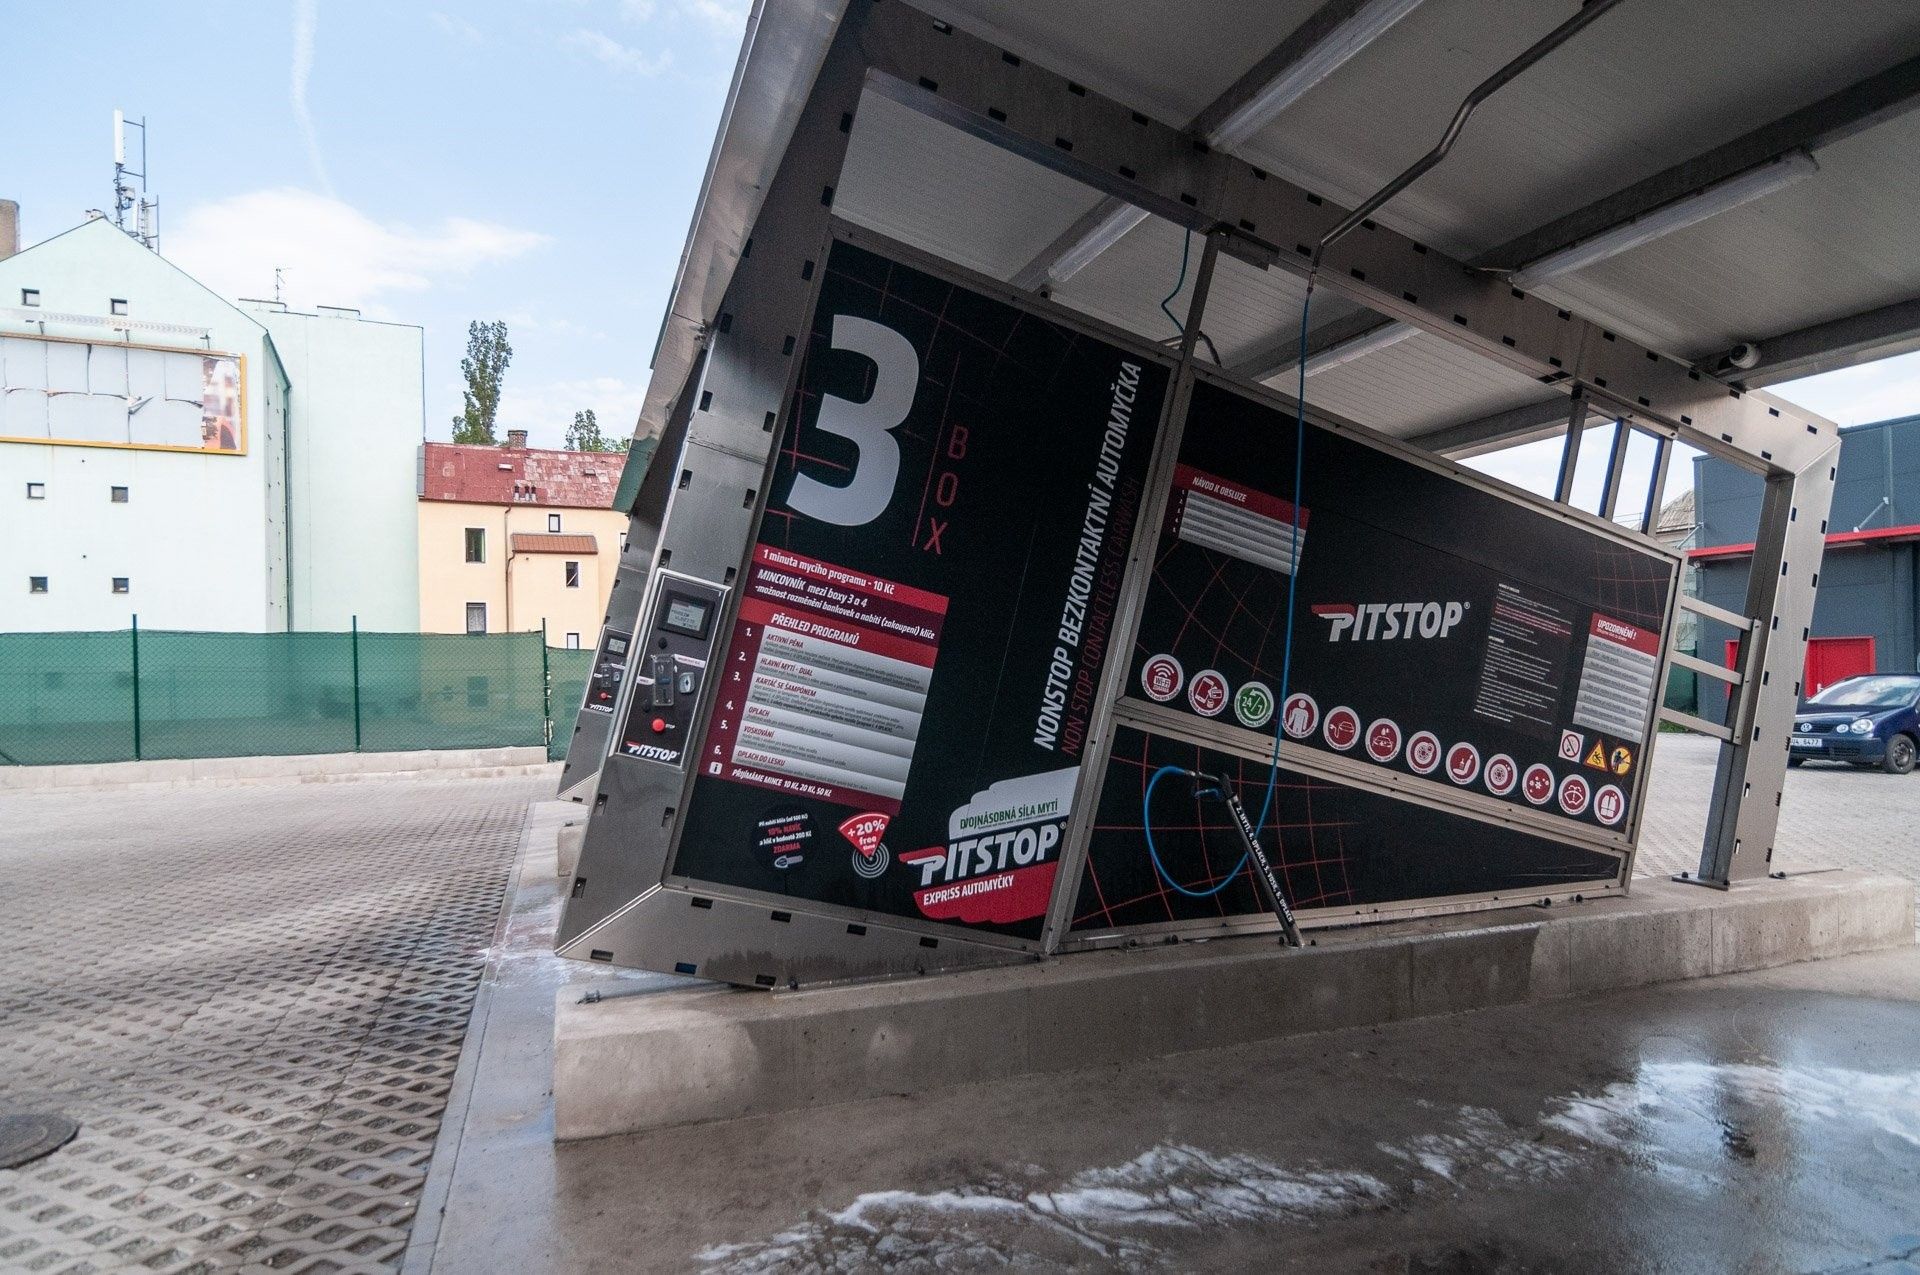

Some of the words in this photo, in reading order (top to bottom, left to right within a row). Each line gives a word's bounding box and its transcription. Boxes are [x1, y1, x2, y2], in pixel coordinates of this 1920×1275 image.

[786, 314, 920, 526] 3
[923, 424, 969, 554] BOX
[1033, 646, 1074, 751] NONSTOP
[1058, 483, 1113, 648] BEZKONTAKTNÍ
[1095, 361, 1142, 490] AUTOMYČKA
[764, 549, 769, 559] 1
[769, 552, 798, 567] minuta
[828, 569, 867, 587] programu
[873, 580, 884, 591] 10
[884, 583, 895, 595] Kč
[757, 568, 807, 591] MINCOVNÍK
[807, 584, 828, 597] mezi
[827, 588, 847, 604] boxy
[847, 593, 855, 604] 3
[861, 598, 868, 608] 4
[822, 601, 855, 618] bankovek
[771, 612, 811, 632] PŘEHLED
[745, 628, 752, 637] 1.
[738, 652, 747, 661] 2.
[733, 671, 741, 681] 3.
[1071, 669, 1095, 715] STOP
[726, 700, 734, 710] 4.
[720, 720, 728, 729] 5.
[1061, 714, 1086, 757] NON
[714, 745, 722, 755] 6.
[764, 776, 783, 787] MINCE
[799, 783, 808, 792] 20
[1018, 803, 1036, 819] SÍLA
[1037, 797, 1058, 816] MYTÍ
[859, 836, 877, 846] free
[961, 874, 1014, 898] AUTOMYČKY
